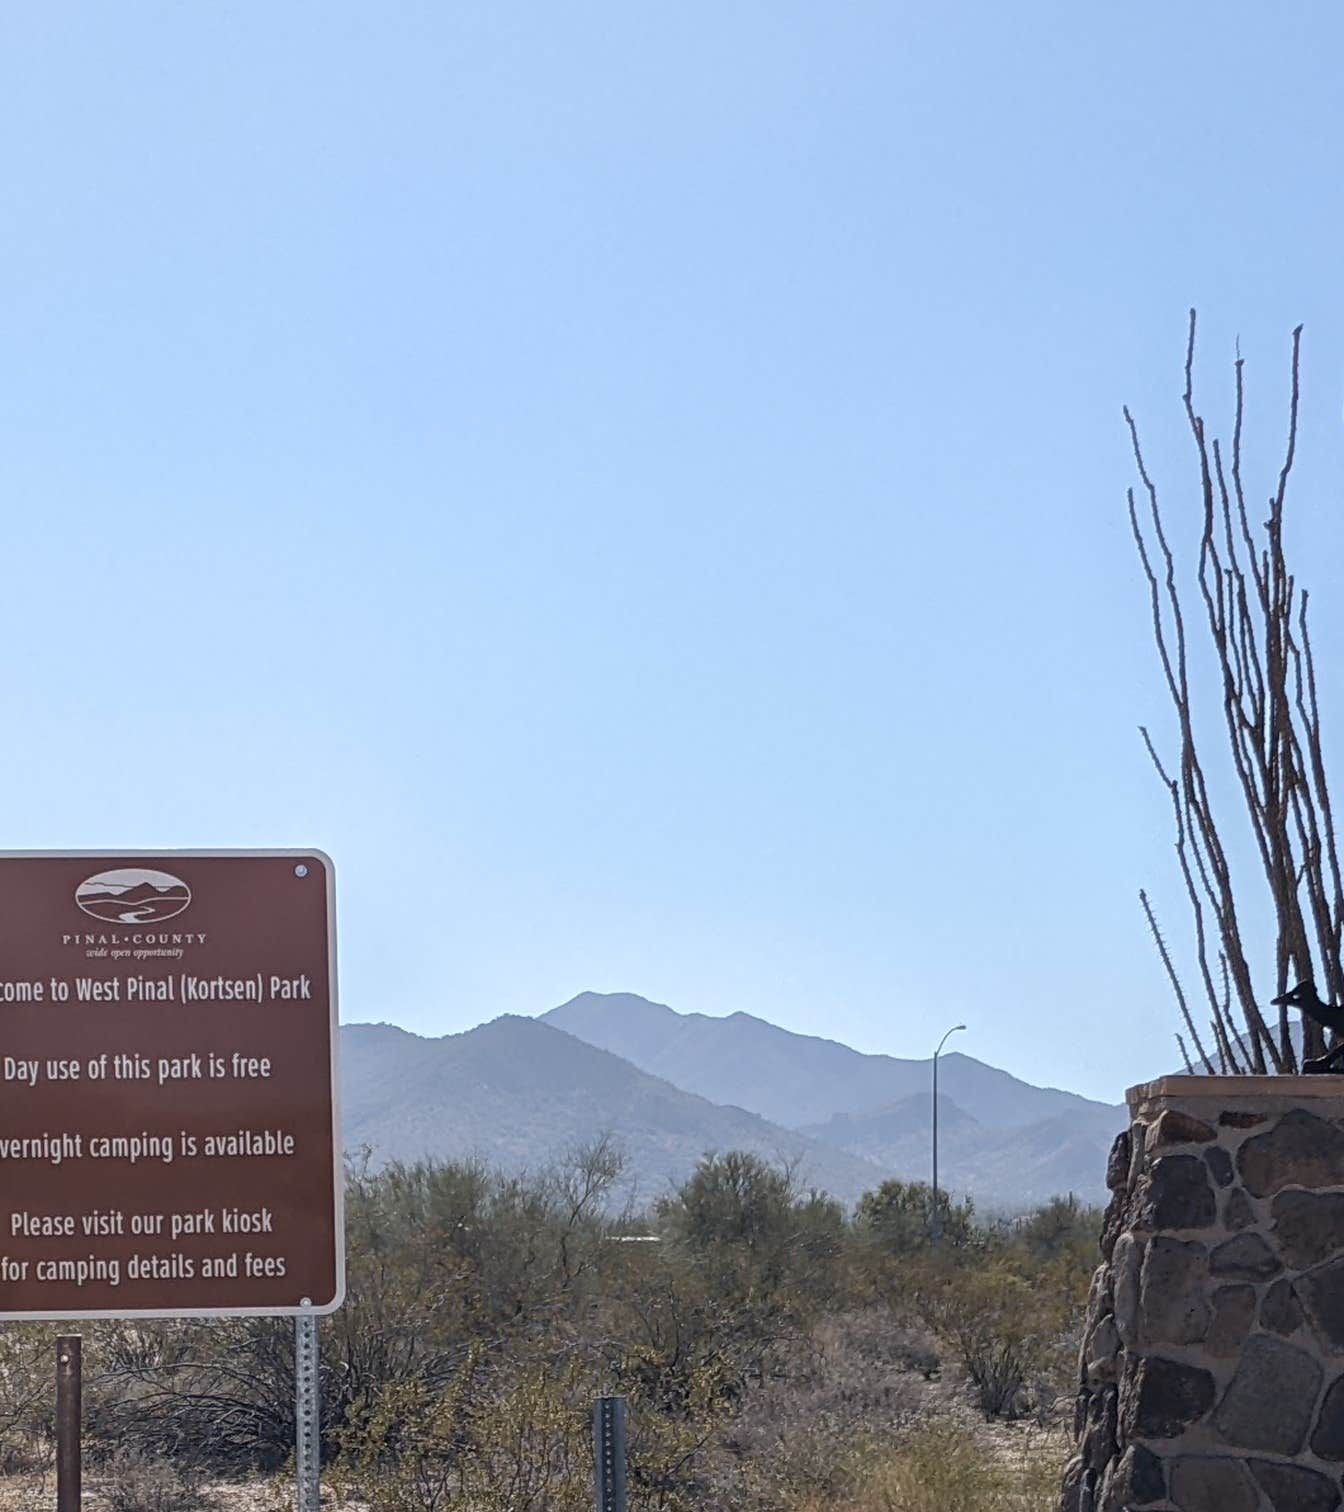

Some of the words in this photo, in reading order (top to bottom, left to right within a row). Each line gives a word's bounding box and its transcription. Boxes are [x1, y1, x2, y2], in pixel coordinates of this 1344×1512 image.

[85, 947, 109, 958] wide
[110, 949, 132, 961] open
[132, 947, 184, 960] opportunity
[49, 977, 69, 1001] to
[75, 976, 120, 1001] West
[127, 975, 175, 1001] Pinal
[180, 973, 263, 1005] (Kortsen)
[270, 974, 311, 1000] Park
[4, 1056, 39, 1087] Day
[46, 1060, 81, 1080] use
[88, 1053, 108, 1080] of
[113, 1053, 151, 1079] this
[158, 1053, 202, 1085] park
[208, 1052, 226, 1078] is
[231, 1052, 271, 1078] free
[89, 1131, 173, 1163] camping
[180, 1130, 198, 1156] is
[204, 1129, 295, 1156] available
[11, 1211, 75, 1236] Please
[81, 1209, 124, 1236] visit
[131, 1215, 164, 1235] our
[171, 1208, 215, 1240] park
[222, 1207, 273, 1233] kiosk
[0, 1255, 30, 1281] for
[36, 1254, 120, 1286] camping
[127, 1253, 195, 1279] details
[201, 1252, 238, 1278] and
[244, 1252, 286, 1278] fees
